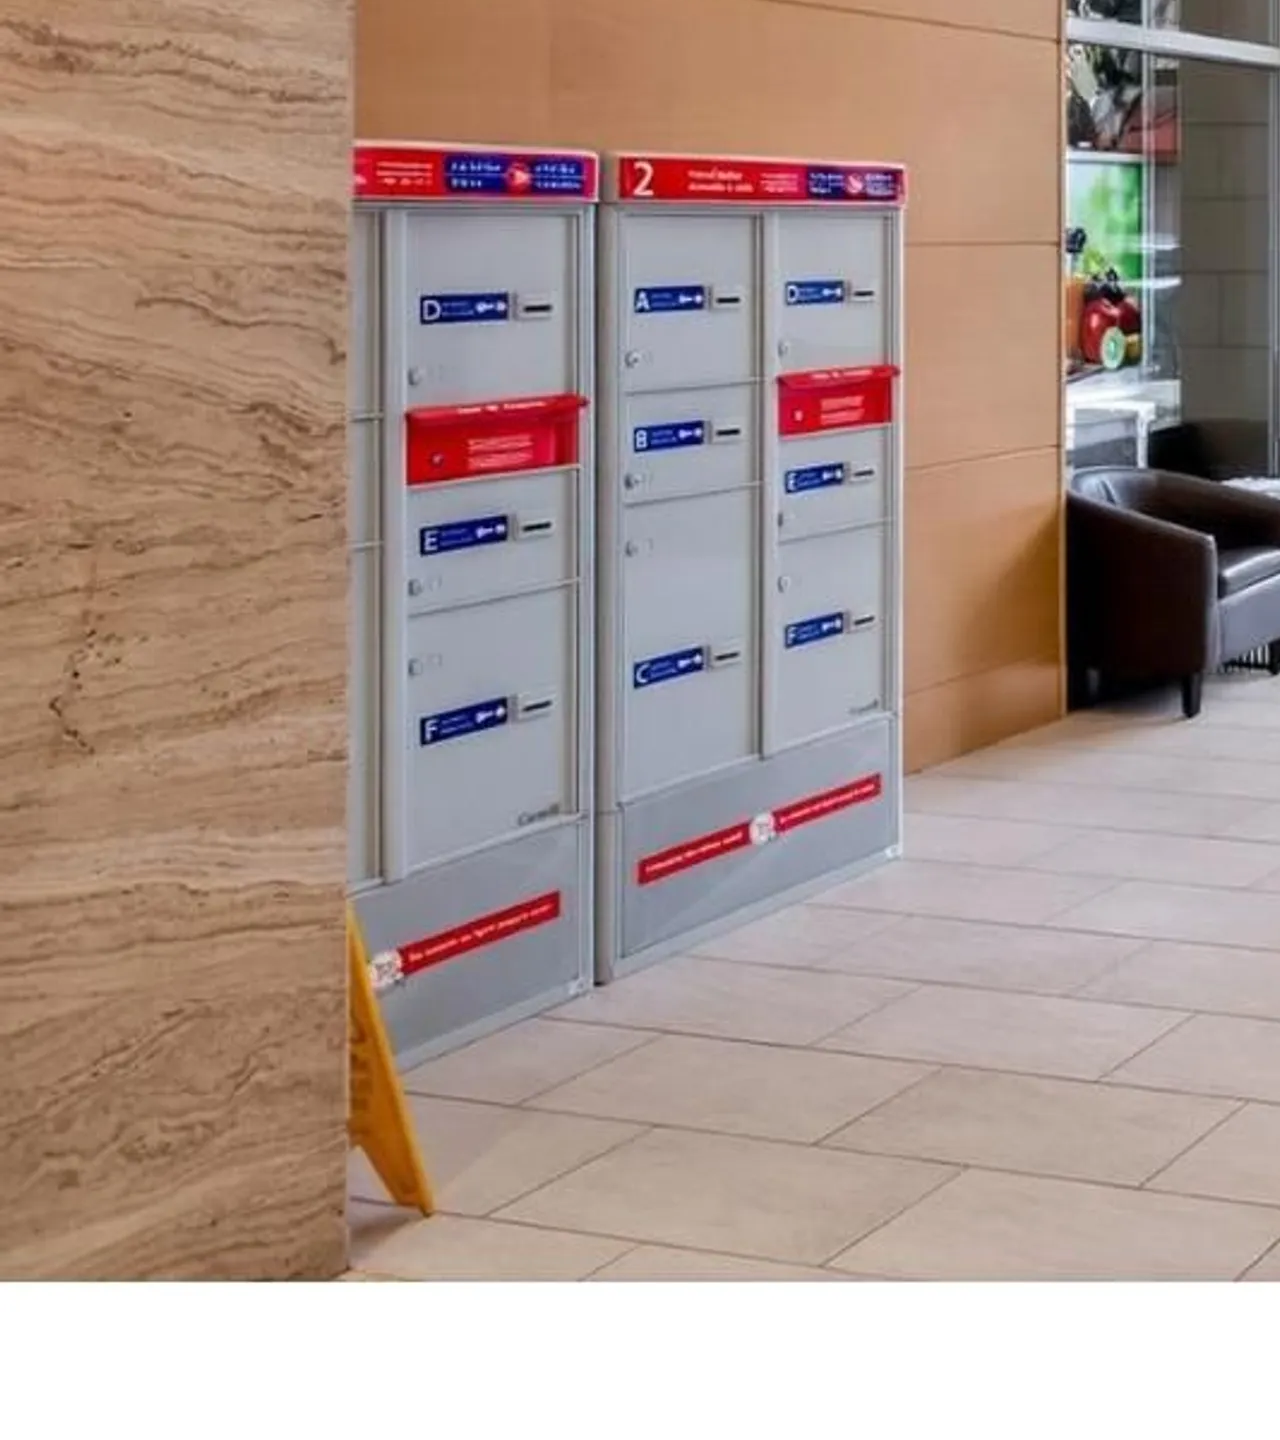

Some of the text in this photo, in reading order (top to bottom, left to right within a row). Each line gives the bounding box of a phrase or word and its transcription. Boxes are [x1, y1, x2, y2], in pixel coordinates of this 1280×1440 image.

[633, 161, 654, 196] 2
[634, 291, 651, 312] A
[787, 284, 799, 303] D
[422, 299, 441, 321] D
[635, 430, 648, 451] B
[786, 472, 797, 493] E
[422, 532, 438, 553] E
[786, 627, 797, 647] F
[635, 663, 649, 685] C
[424, 720, 439, 744] F
